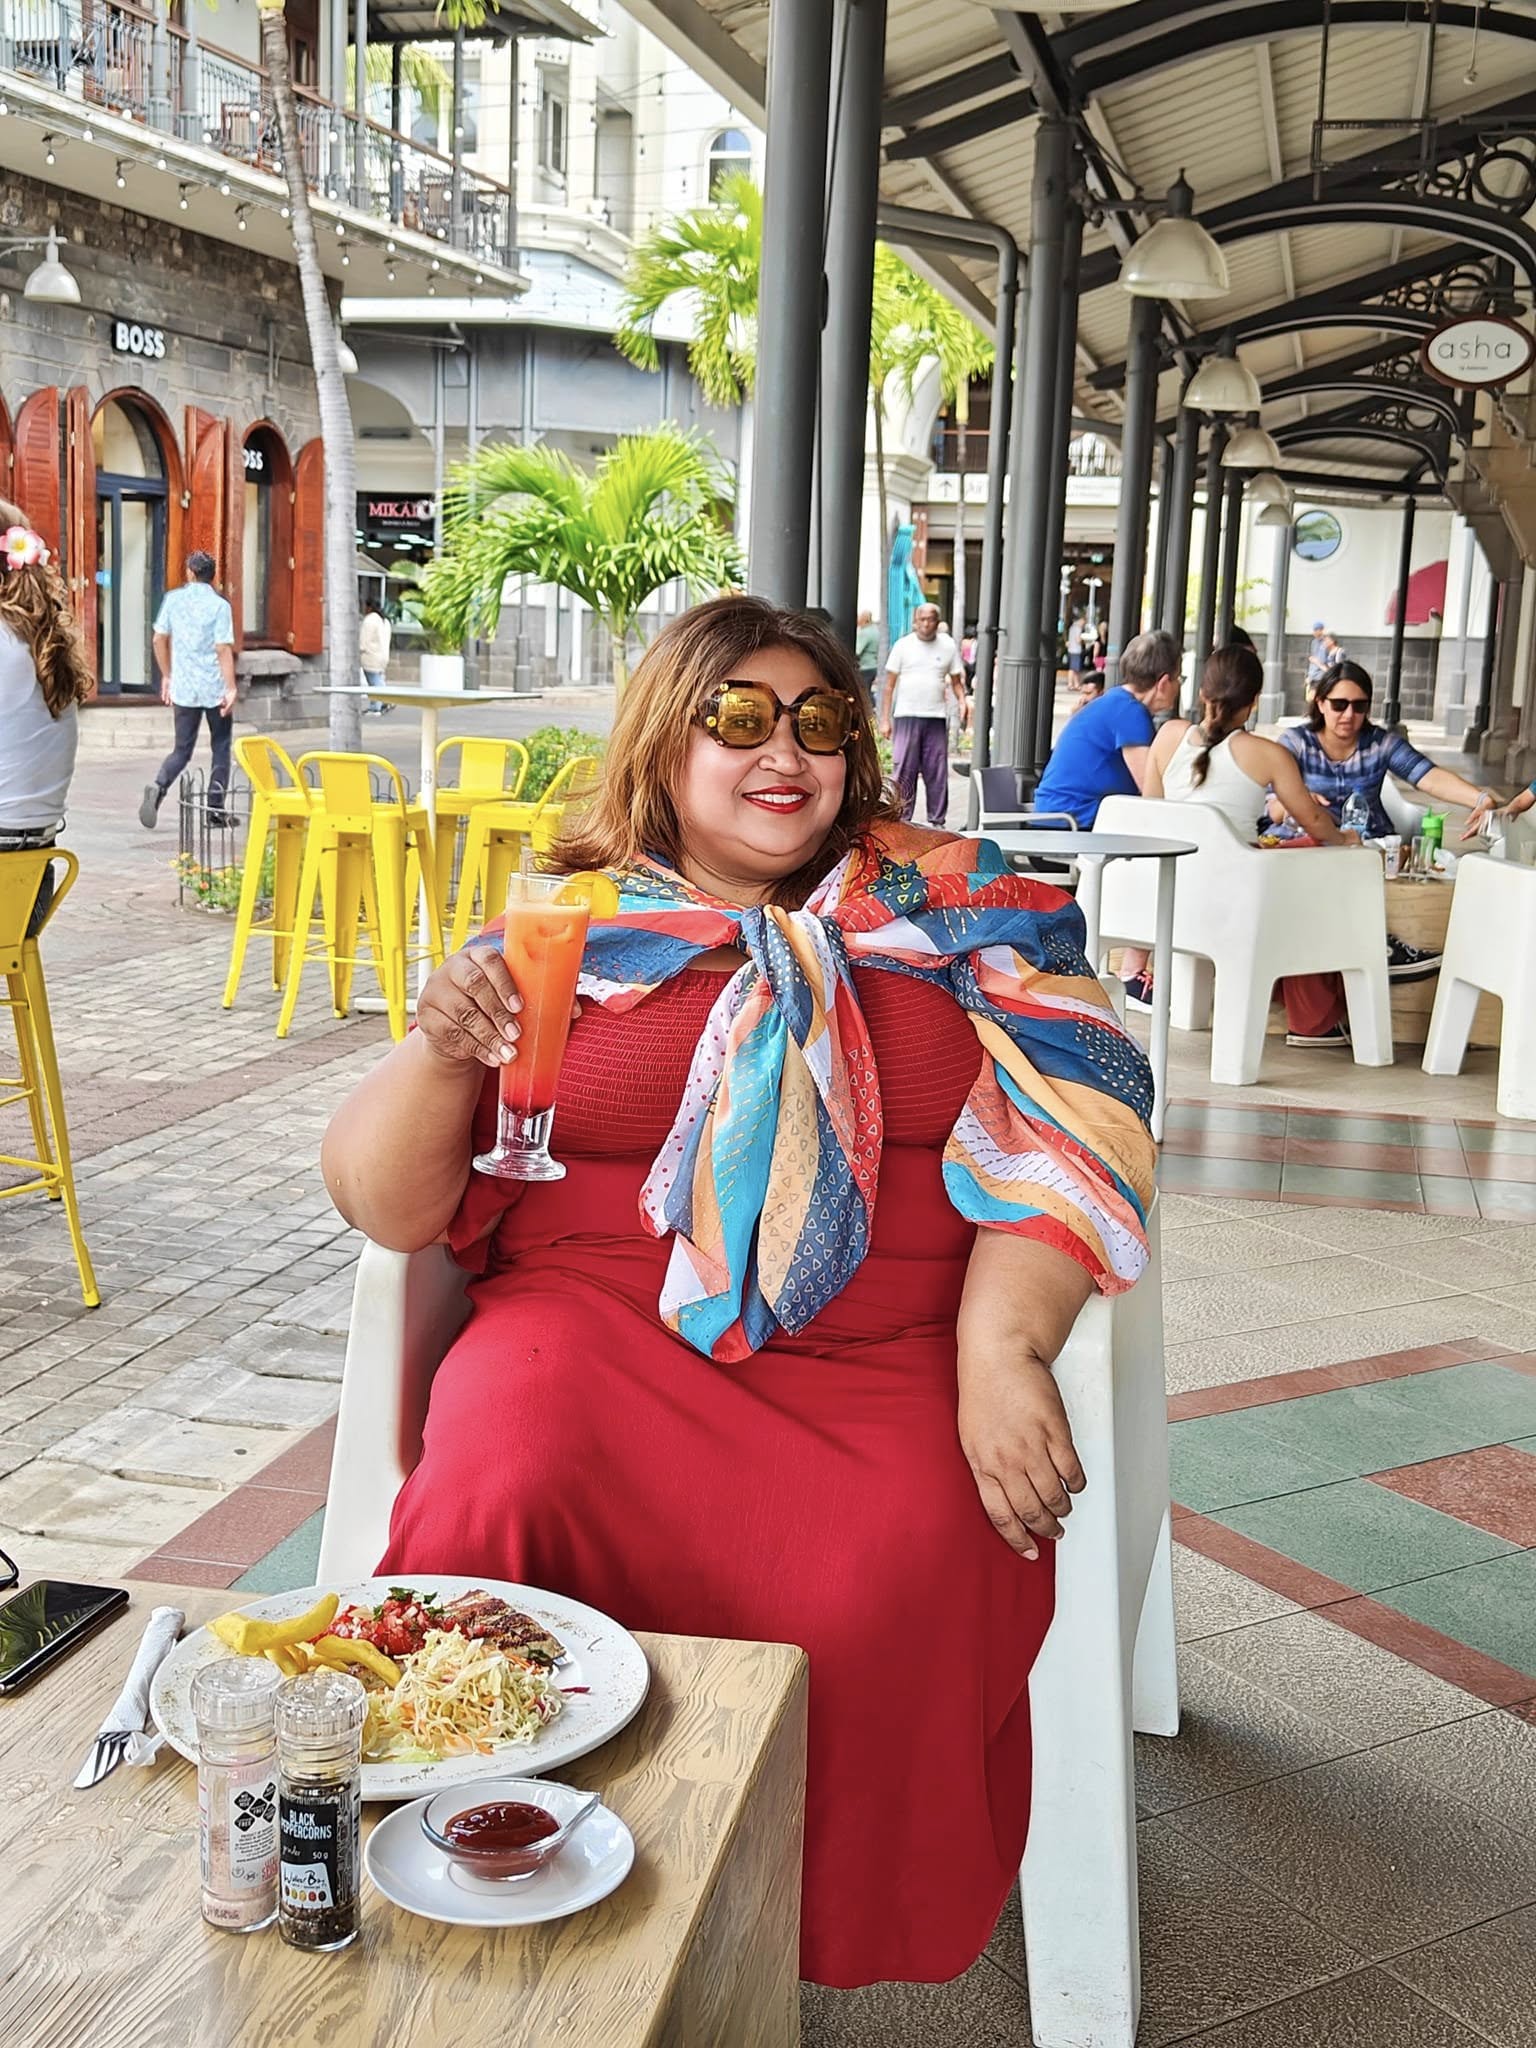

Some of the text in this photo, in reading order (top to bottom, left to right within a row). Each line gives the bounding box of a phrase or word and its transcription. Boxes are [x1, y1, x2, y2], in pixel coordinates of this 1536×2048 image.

[116, 321, 165, 358] BOSS
[1437, 334, 1511, 359] asha
[243, 448, 263, 471] OSS
[424, 769, 433, 785] 8
[289, 1809, 316, 1826] BLACK
